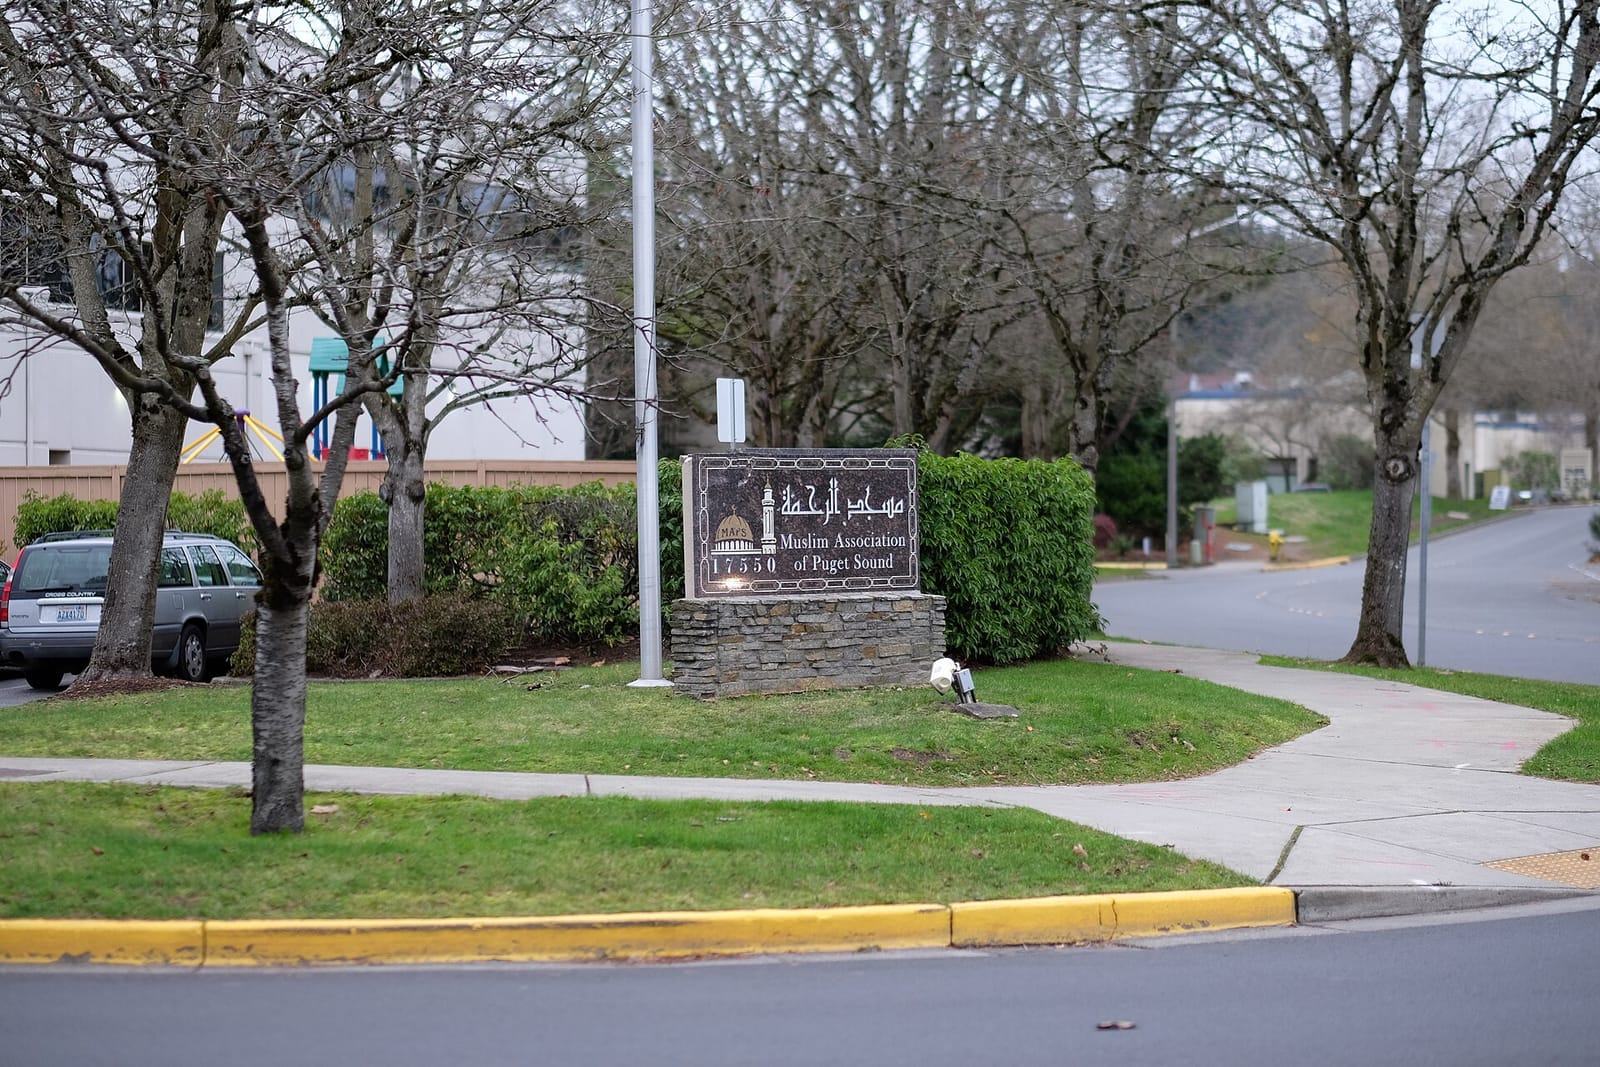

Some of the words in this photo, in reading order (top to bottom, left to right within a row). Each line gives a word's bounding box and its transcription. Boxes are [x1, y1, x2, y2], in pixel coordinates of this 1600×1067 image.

[781, 477, 841, 526] الرحمة
[847, 485, 904, 521] مسجد
[721, 527, 748, 538] MAPS
[780, 532, 829, 550] Muslim
[834, 531, 906, 548] Association
[711, 556, 777, 574] 17550
[794, 555, 808, 571] of
[812, 555, 849, 575] Puget
[853, 552, 893, 570] Sound
